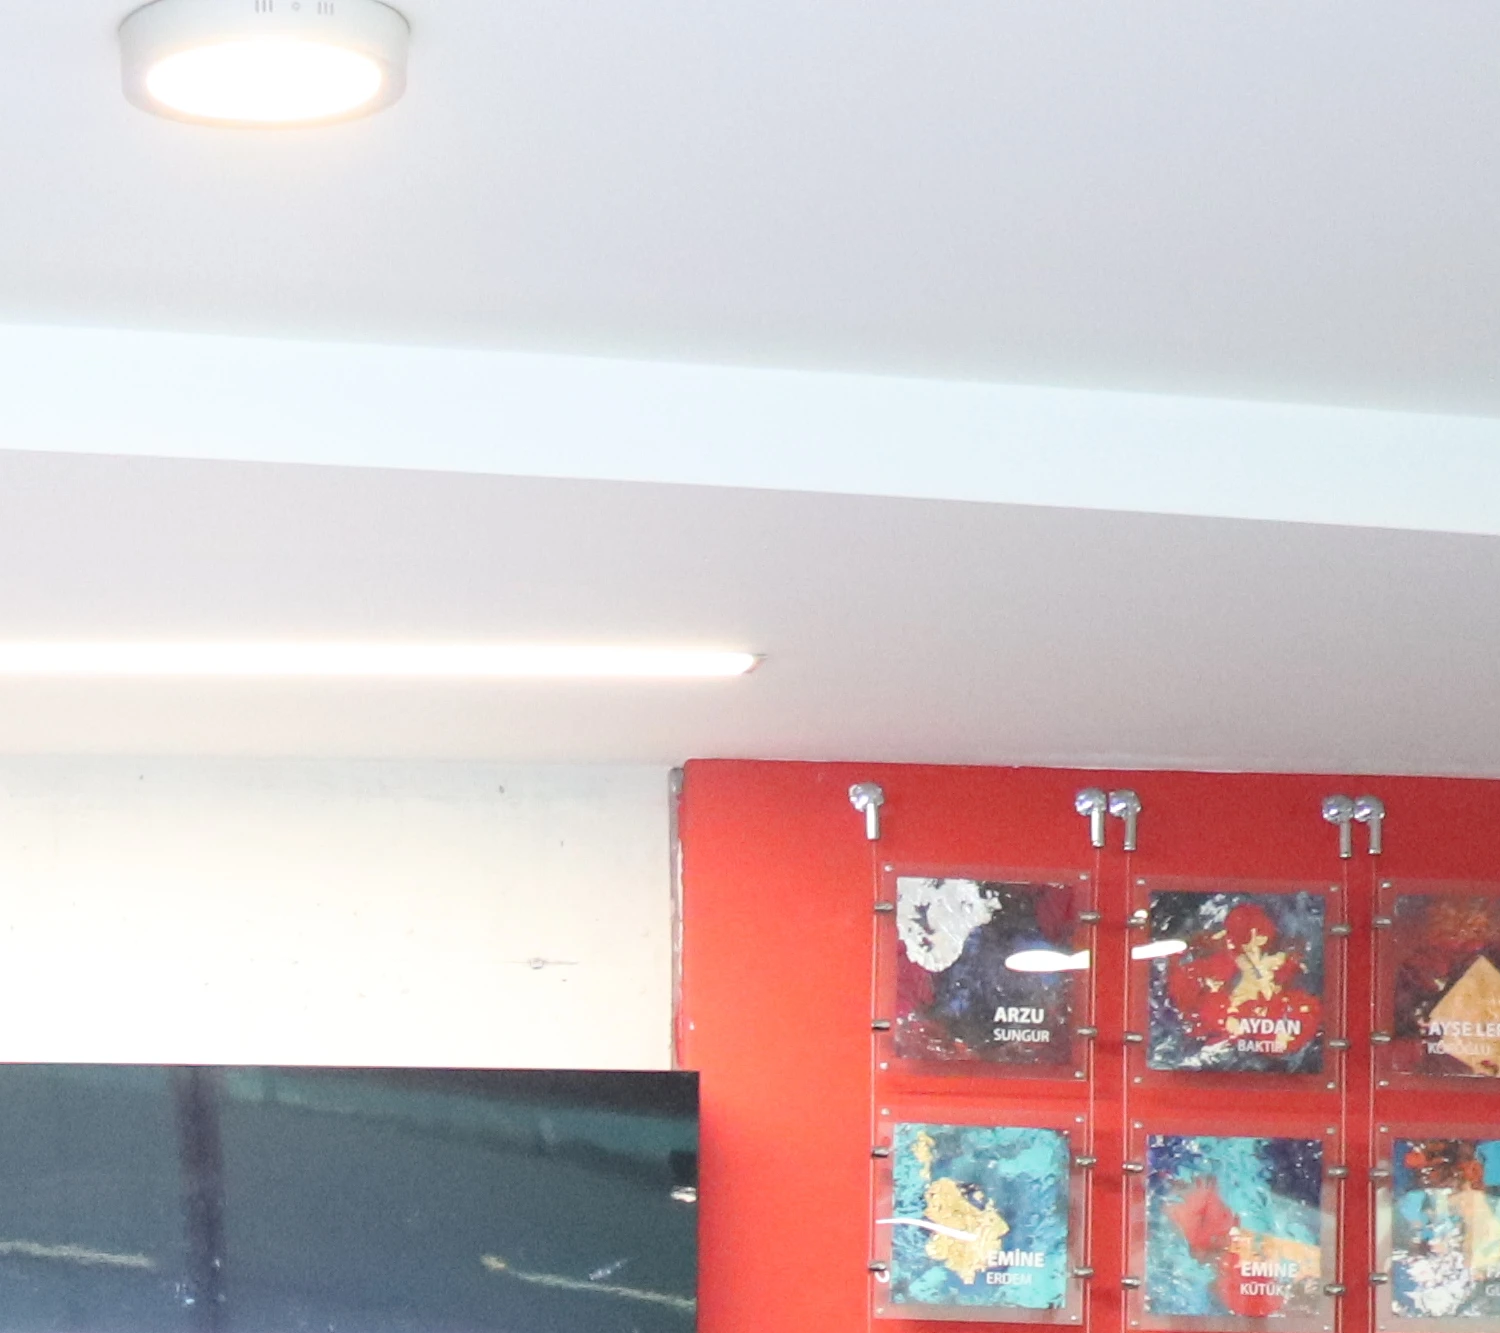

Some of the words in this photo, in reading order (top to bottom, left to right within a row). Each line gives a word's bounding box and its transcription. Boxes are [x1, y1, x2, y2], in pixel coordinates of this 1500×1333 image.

[993, 1006, 1045, 1024] ARZU
[1239, 1018, 1301, 1035] AYDAN
[993, 1028, 1050, 1043] SUNGUR
[986, 1248, 1045, 1268] EMİNE
[986, 1271, 1032, 1285] ERDEM
